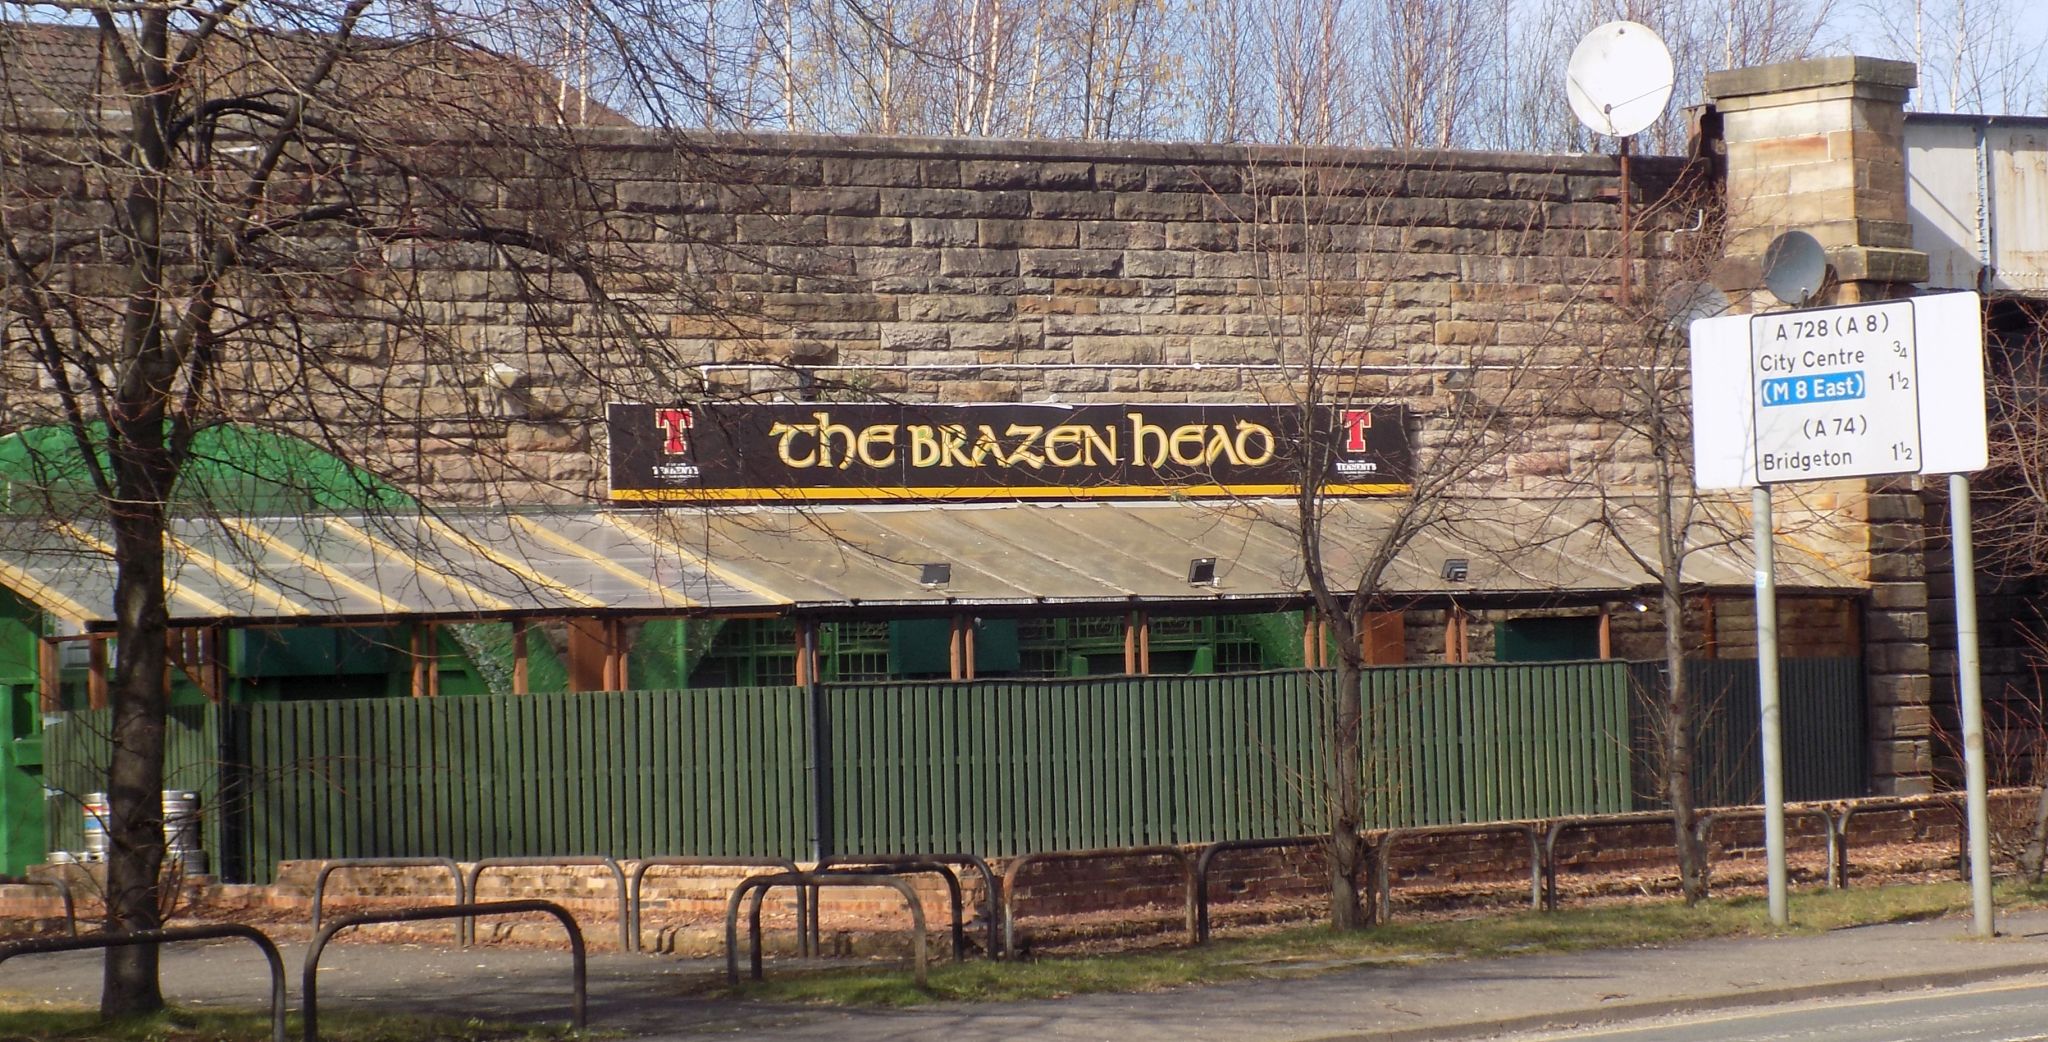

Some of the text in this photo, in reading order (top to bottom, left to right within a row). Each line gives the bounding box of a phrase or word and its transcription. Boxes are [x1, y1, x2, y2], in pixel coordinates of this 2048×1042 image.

[1776, 323, 1788, 341] A
[1794, 319, 1829, 340] 728
[1760, 353, 1796, 373] City
[1802, 348, 1865, 368] Centre
[1762, 381, 1790, 404] (M
[1795, 380, 1808, 400] 8
[1813, 373, 1866, 398] East)
[1832, 414, 1868, 437] 74)
[906, 423, 1117, 469] BRAZEN
[1763, 450, 1853, 472] Bridgeton
